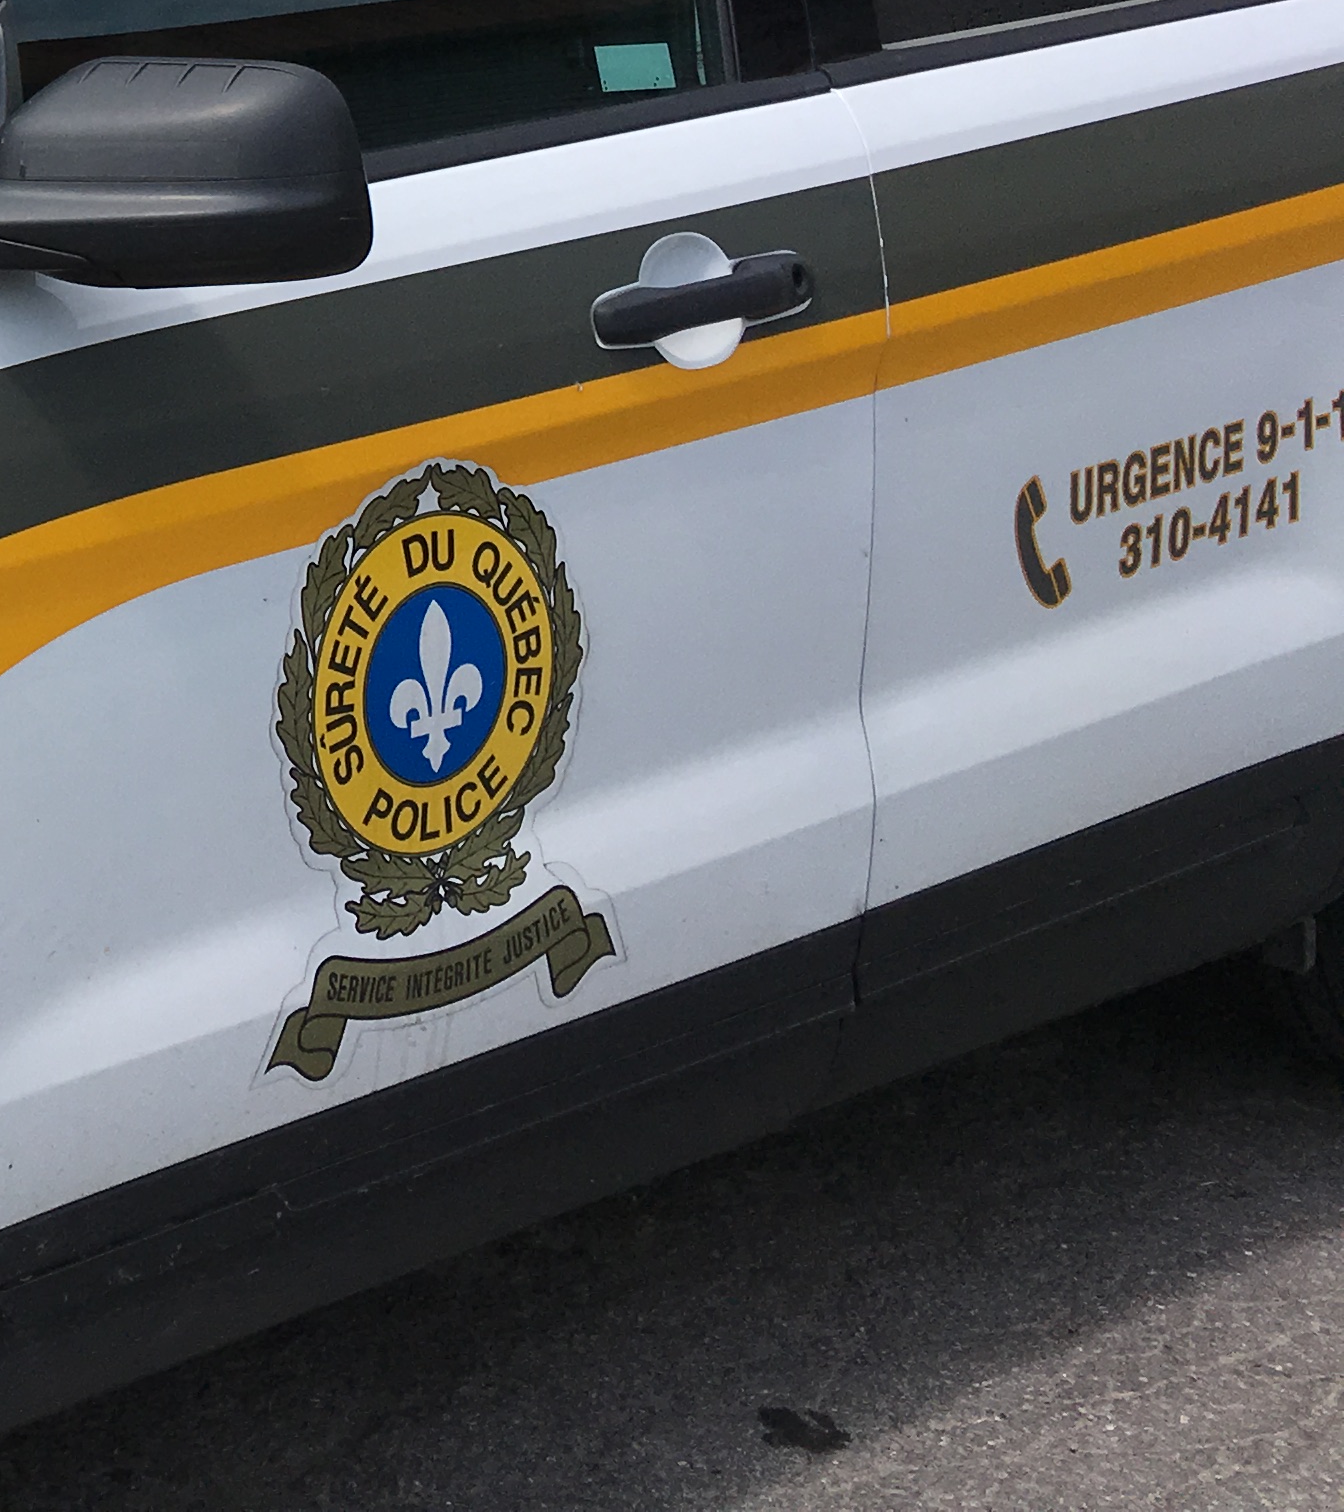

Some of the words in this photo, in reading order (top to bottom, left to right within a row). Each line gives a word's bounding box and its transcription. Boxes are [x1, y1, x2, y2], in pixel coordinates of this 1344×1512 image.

[1069, 417, 1246, 525] URGENCE
[1118, 469, 1302, 579] 310-4141
[319, 574, 390, 787] SÛRETÉ
[401, 528, 456, 579] DU
[471, 540, 544, 738] QUÉBEC
[361, 753, 510, 843] POLICE
[327, 971, 397, 1004] SERVICE
[502, 898, 572, 965] JUSTICE
